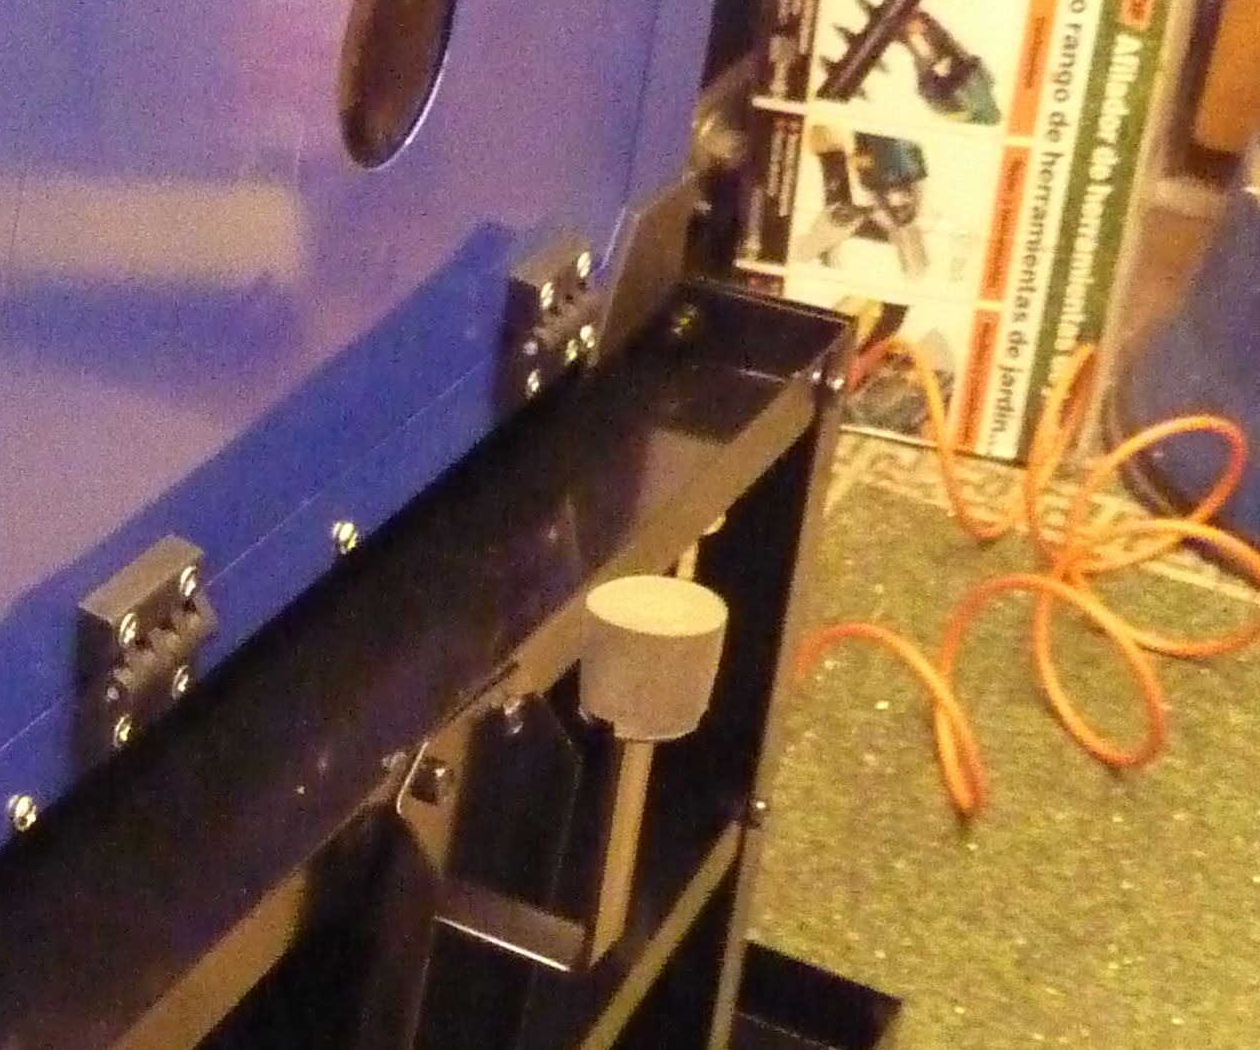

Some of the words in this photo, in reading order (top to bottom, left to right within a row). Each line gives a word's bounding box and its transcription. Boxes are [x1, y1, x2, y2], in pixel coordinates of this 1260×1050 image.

[1052, 22, 1083, 103] rango
[1097, 33, 1143, 144] Afilador
[1047, 110, 1070, 144] de
[1089, 146, 1121, 181] de
[1012, 151, 1064, 323] herramientas
[1053, 183, 1117, 352] herramientas
[1006, 330, 1028, 360] de
